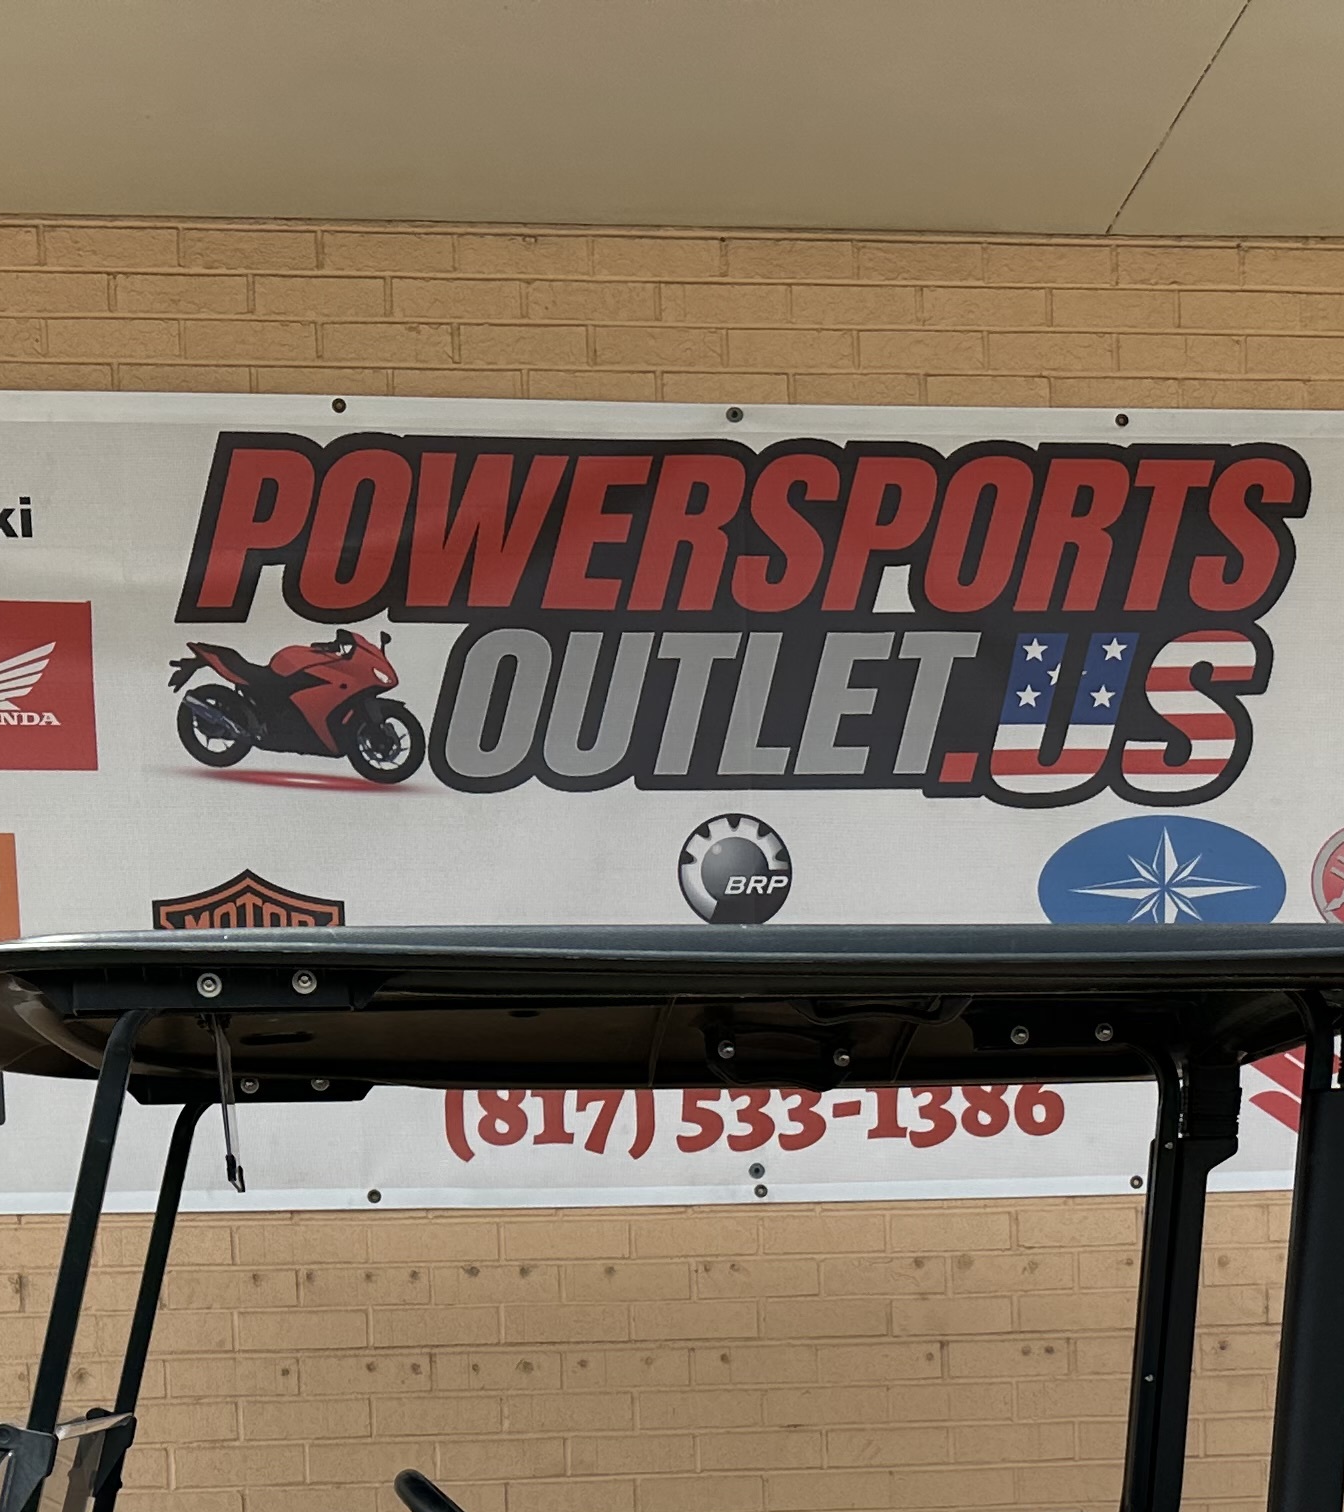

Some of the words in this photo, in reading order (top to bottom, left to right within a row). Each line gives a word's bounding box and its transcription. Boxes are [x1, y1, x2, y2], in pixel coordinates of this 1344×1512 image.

[192, 444, 1302, 616] POWERSPORTS
[723, 875, 789, 895] BRP
[444, 1087, 656, 1163] (817)
[675, 1083, 1066, 1154] 533-1386
